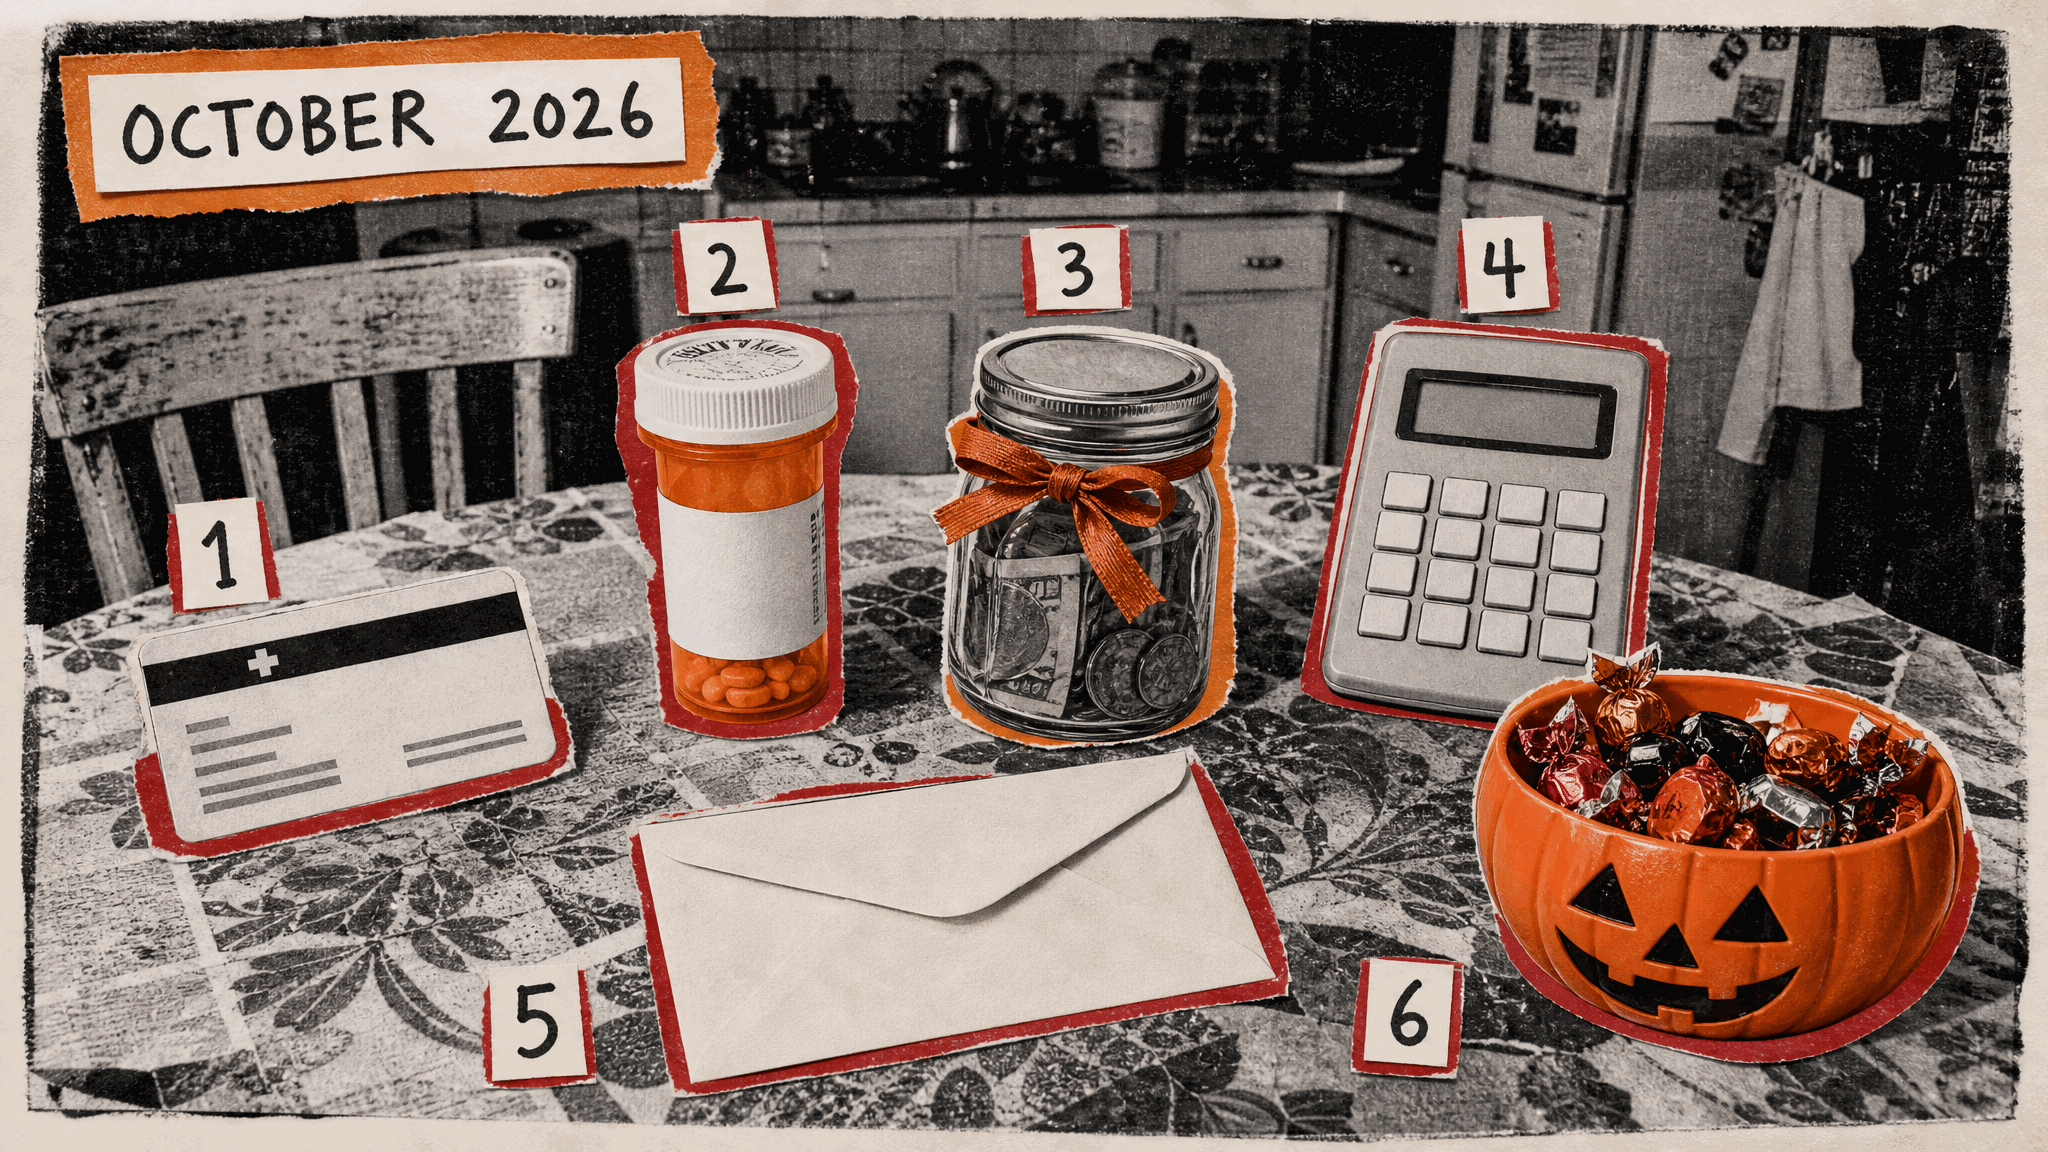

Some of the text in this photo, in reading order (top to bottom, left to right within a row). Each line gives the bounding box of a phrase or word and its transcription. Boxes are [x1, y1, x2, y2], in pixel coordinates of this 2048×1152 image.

[122, 81, 654, 165] OCTOBER 2026
[708, 242, 747, 296] 2
[1057, 241, 1094, 298] 3
[1483, 237, 1526, 299] 4
[201, 520, 237, 590] 1
[516, 982, 559, 1059] 5
[1390, 978, 1429, 1047] 6
